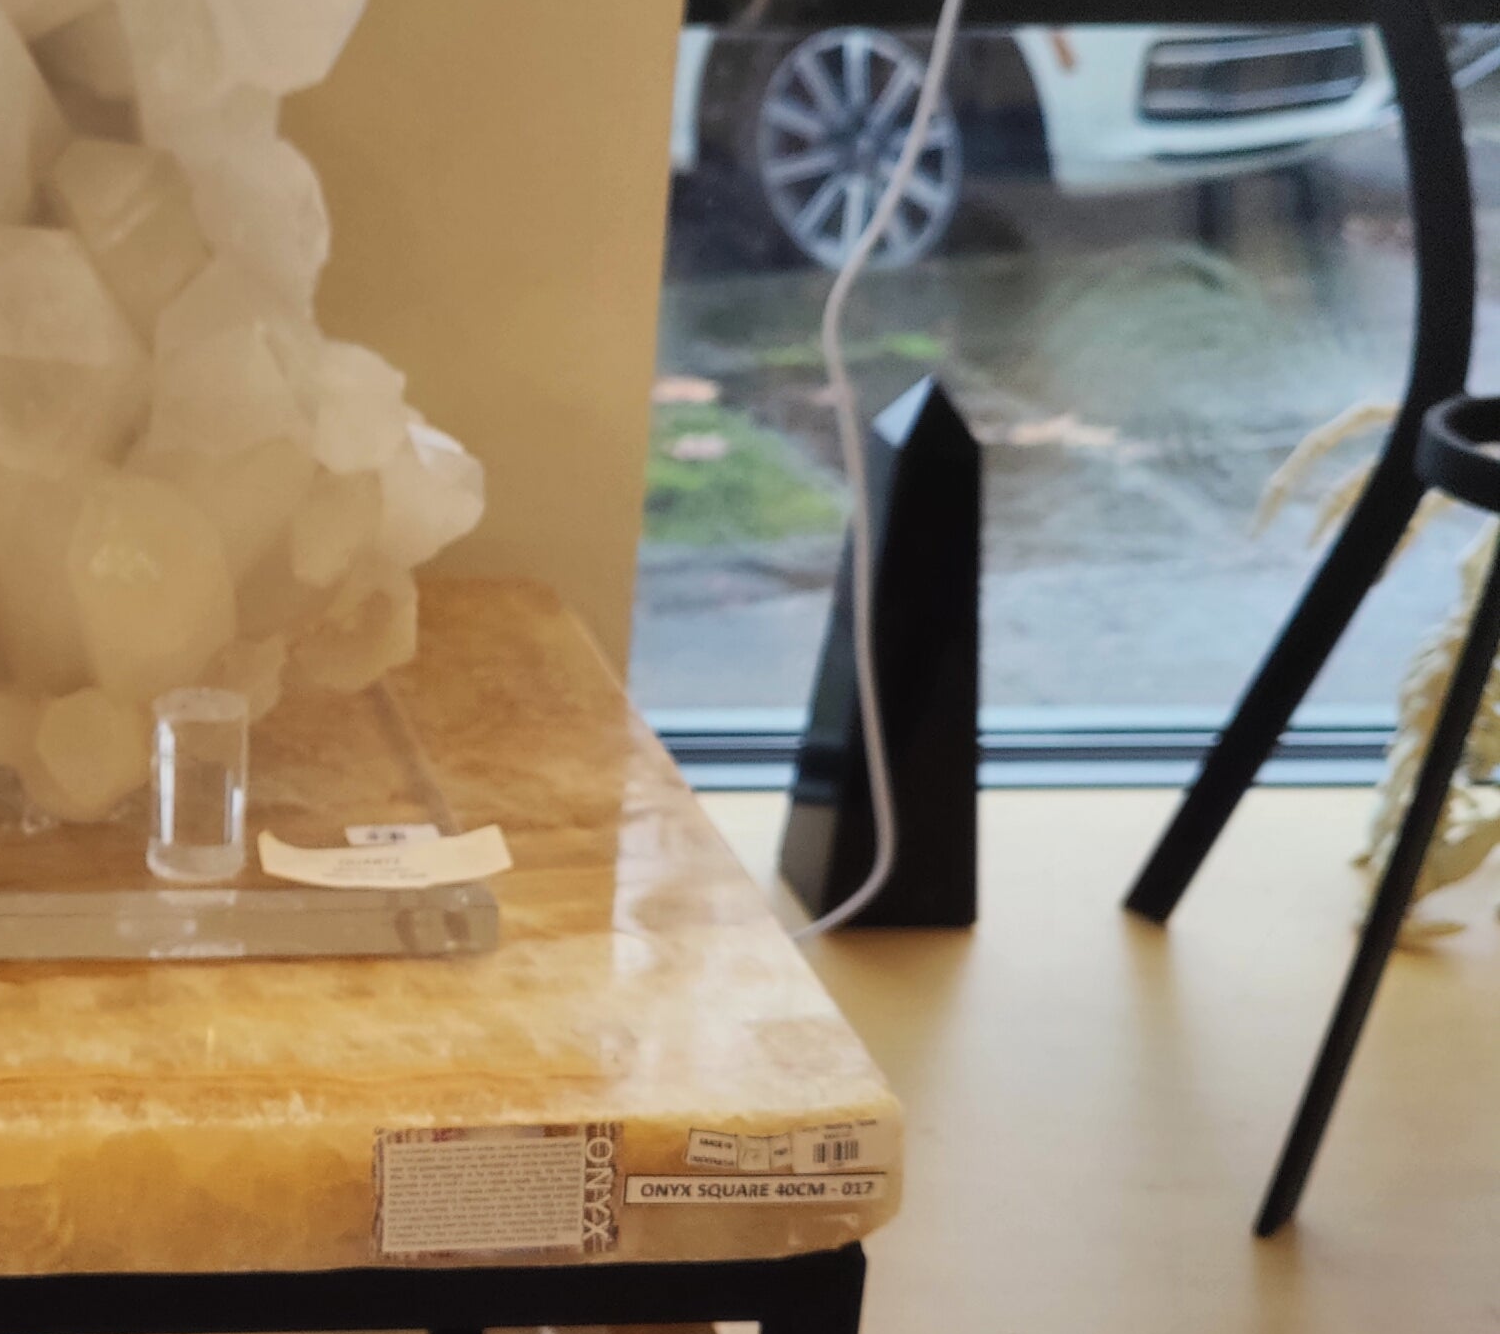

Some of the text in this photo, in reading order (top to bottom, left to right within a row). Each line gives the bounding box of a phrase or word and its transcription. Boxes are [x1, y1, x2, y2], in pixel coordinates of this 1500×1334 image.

[583, 1136, 613, 1241] ONYX
[640, 1182, 692, 1198] ONYX
[697, 1182, 770, 1199] SQUARE
[775, 1182, 825, 1197] 40CM
[841, 1180, 874, 1196] 017
